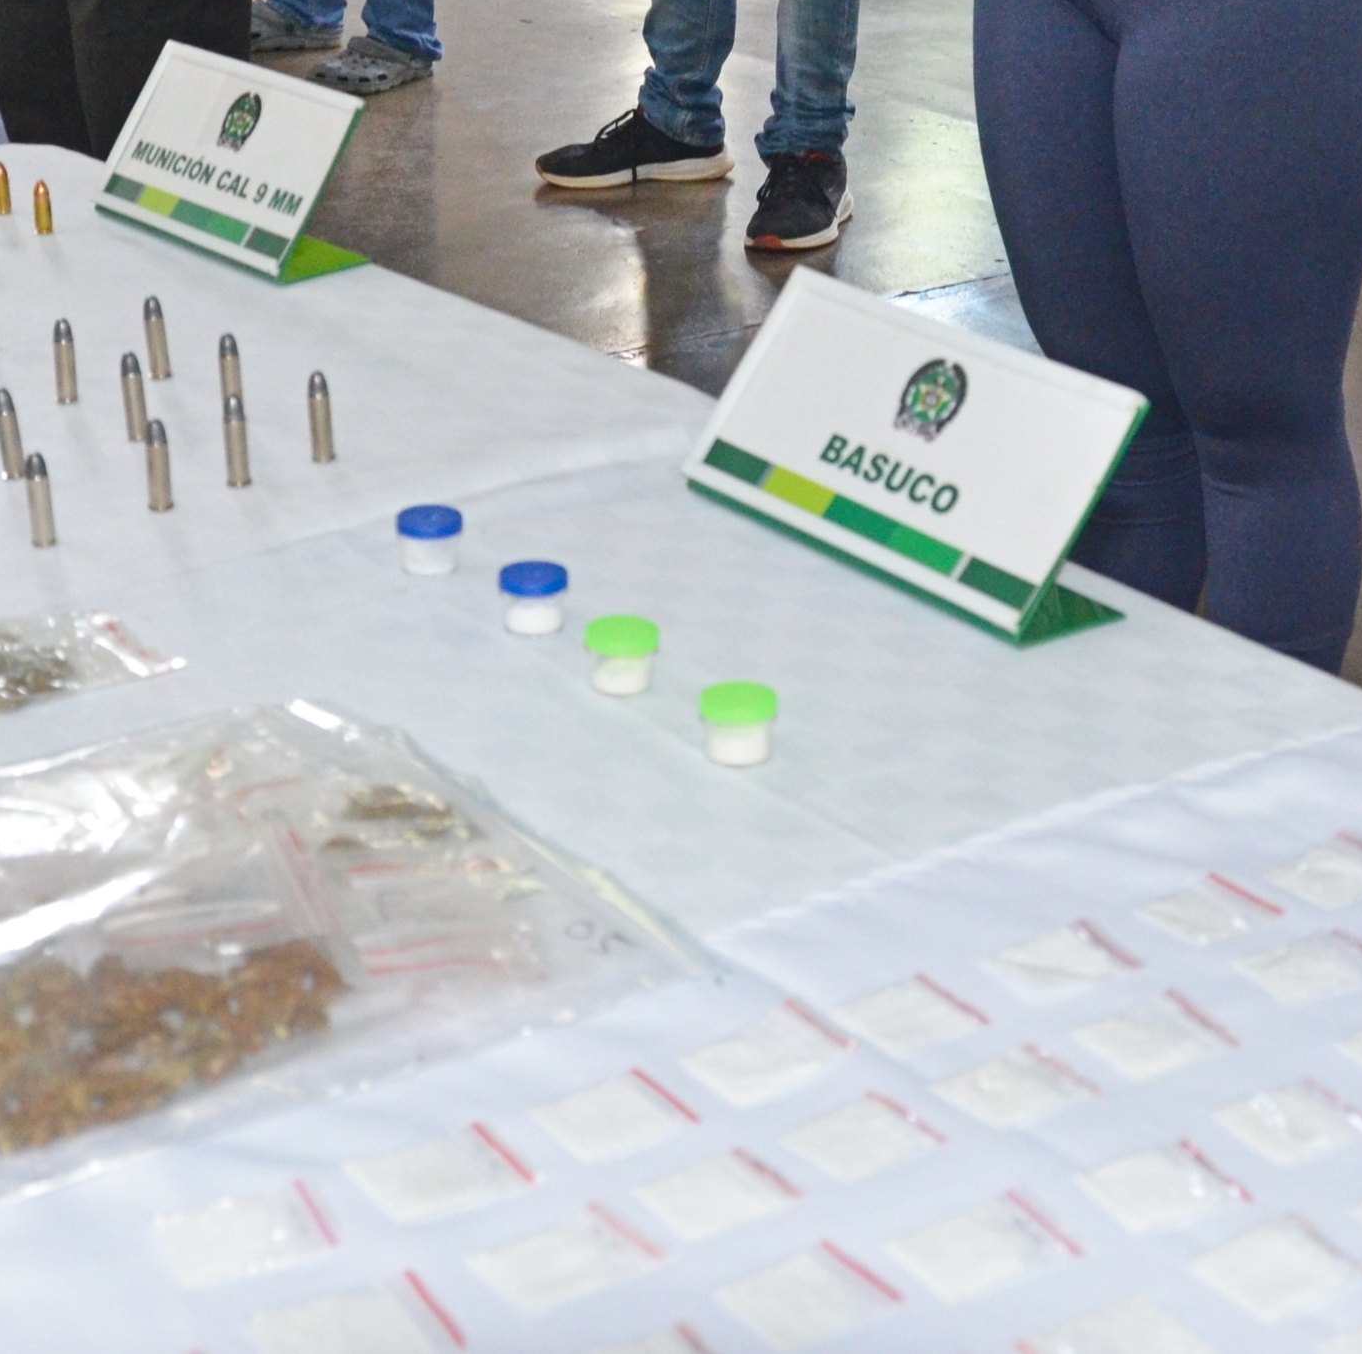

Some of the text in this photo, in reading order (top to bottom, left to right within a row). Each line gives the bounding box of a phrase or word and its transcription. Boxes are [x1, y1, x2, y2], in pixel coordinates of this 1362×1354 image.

[132, 140, 303, 217] MUNICIÓN CAL 9 MM
[820, 434, 959, 514] BASUCO
